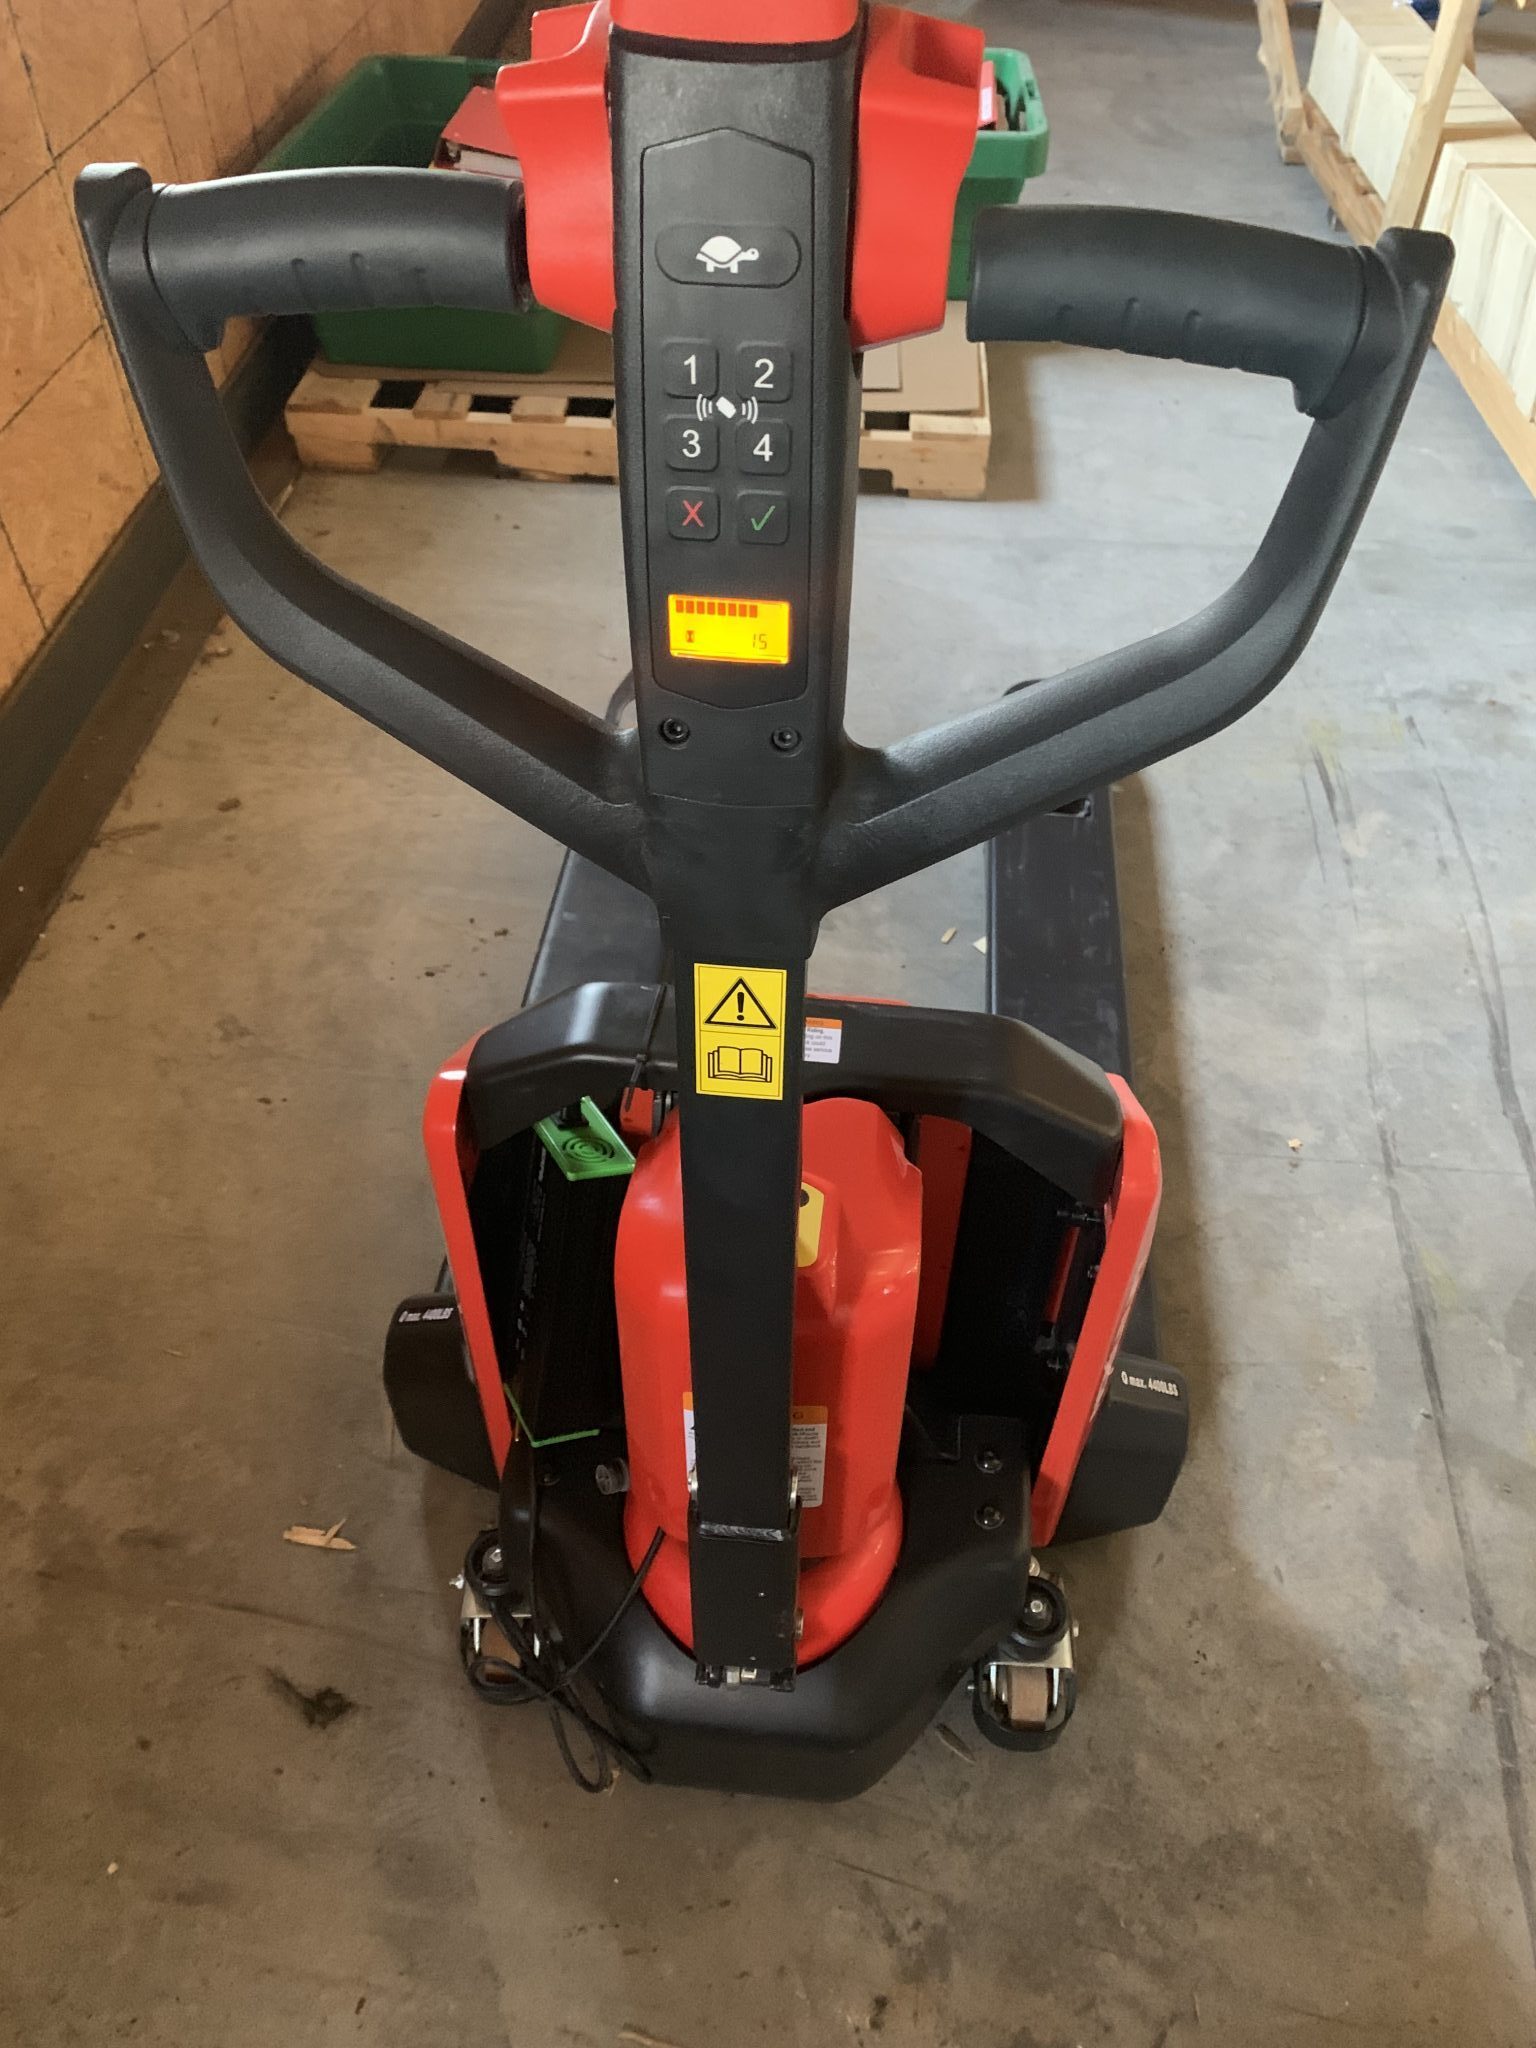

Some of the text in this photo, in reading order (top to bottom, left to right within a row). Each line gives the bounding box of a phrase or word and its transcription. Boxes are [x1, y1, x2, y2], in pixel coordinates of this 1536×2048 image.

[683, 354, 775, 389] 1 2
[682, 429, 774, 462] 3 4
[752, 633, 768, 650] 15
